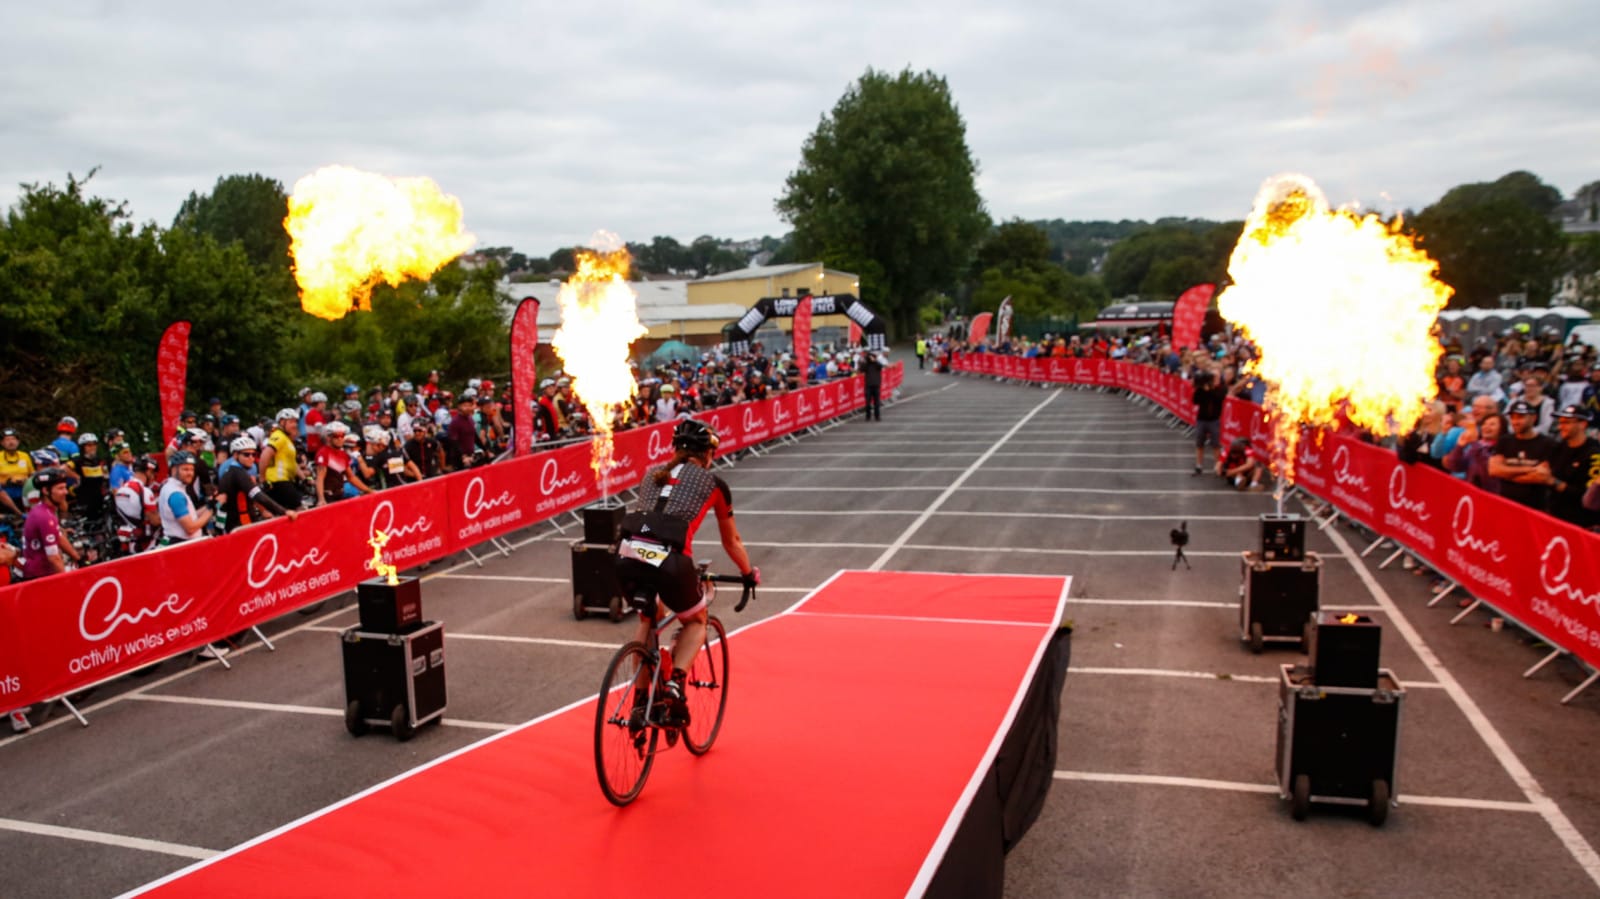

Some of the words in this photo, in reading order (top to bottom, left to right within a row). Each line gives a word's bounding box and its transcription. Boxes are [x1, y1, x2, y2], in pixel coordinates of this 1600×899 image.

[637, 548, 657, 559] 90
[239, 591, 277, 616] activity
[278, 580, 307, 600] wales
[308, 567, 341, 590] events
[69, 643, 122, 674] activity
[124, 632, 164, 656] wales
[166, 616, 208, 641] events
